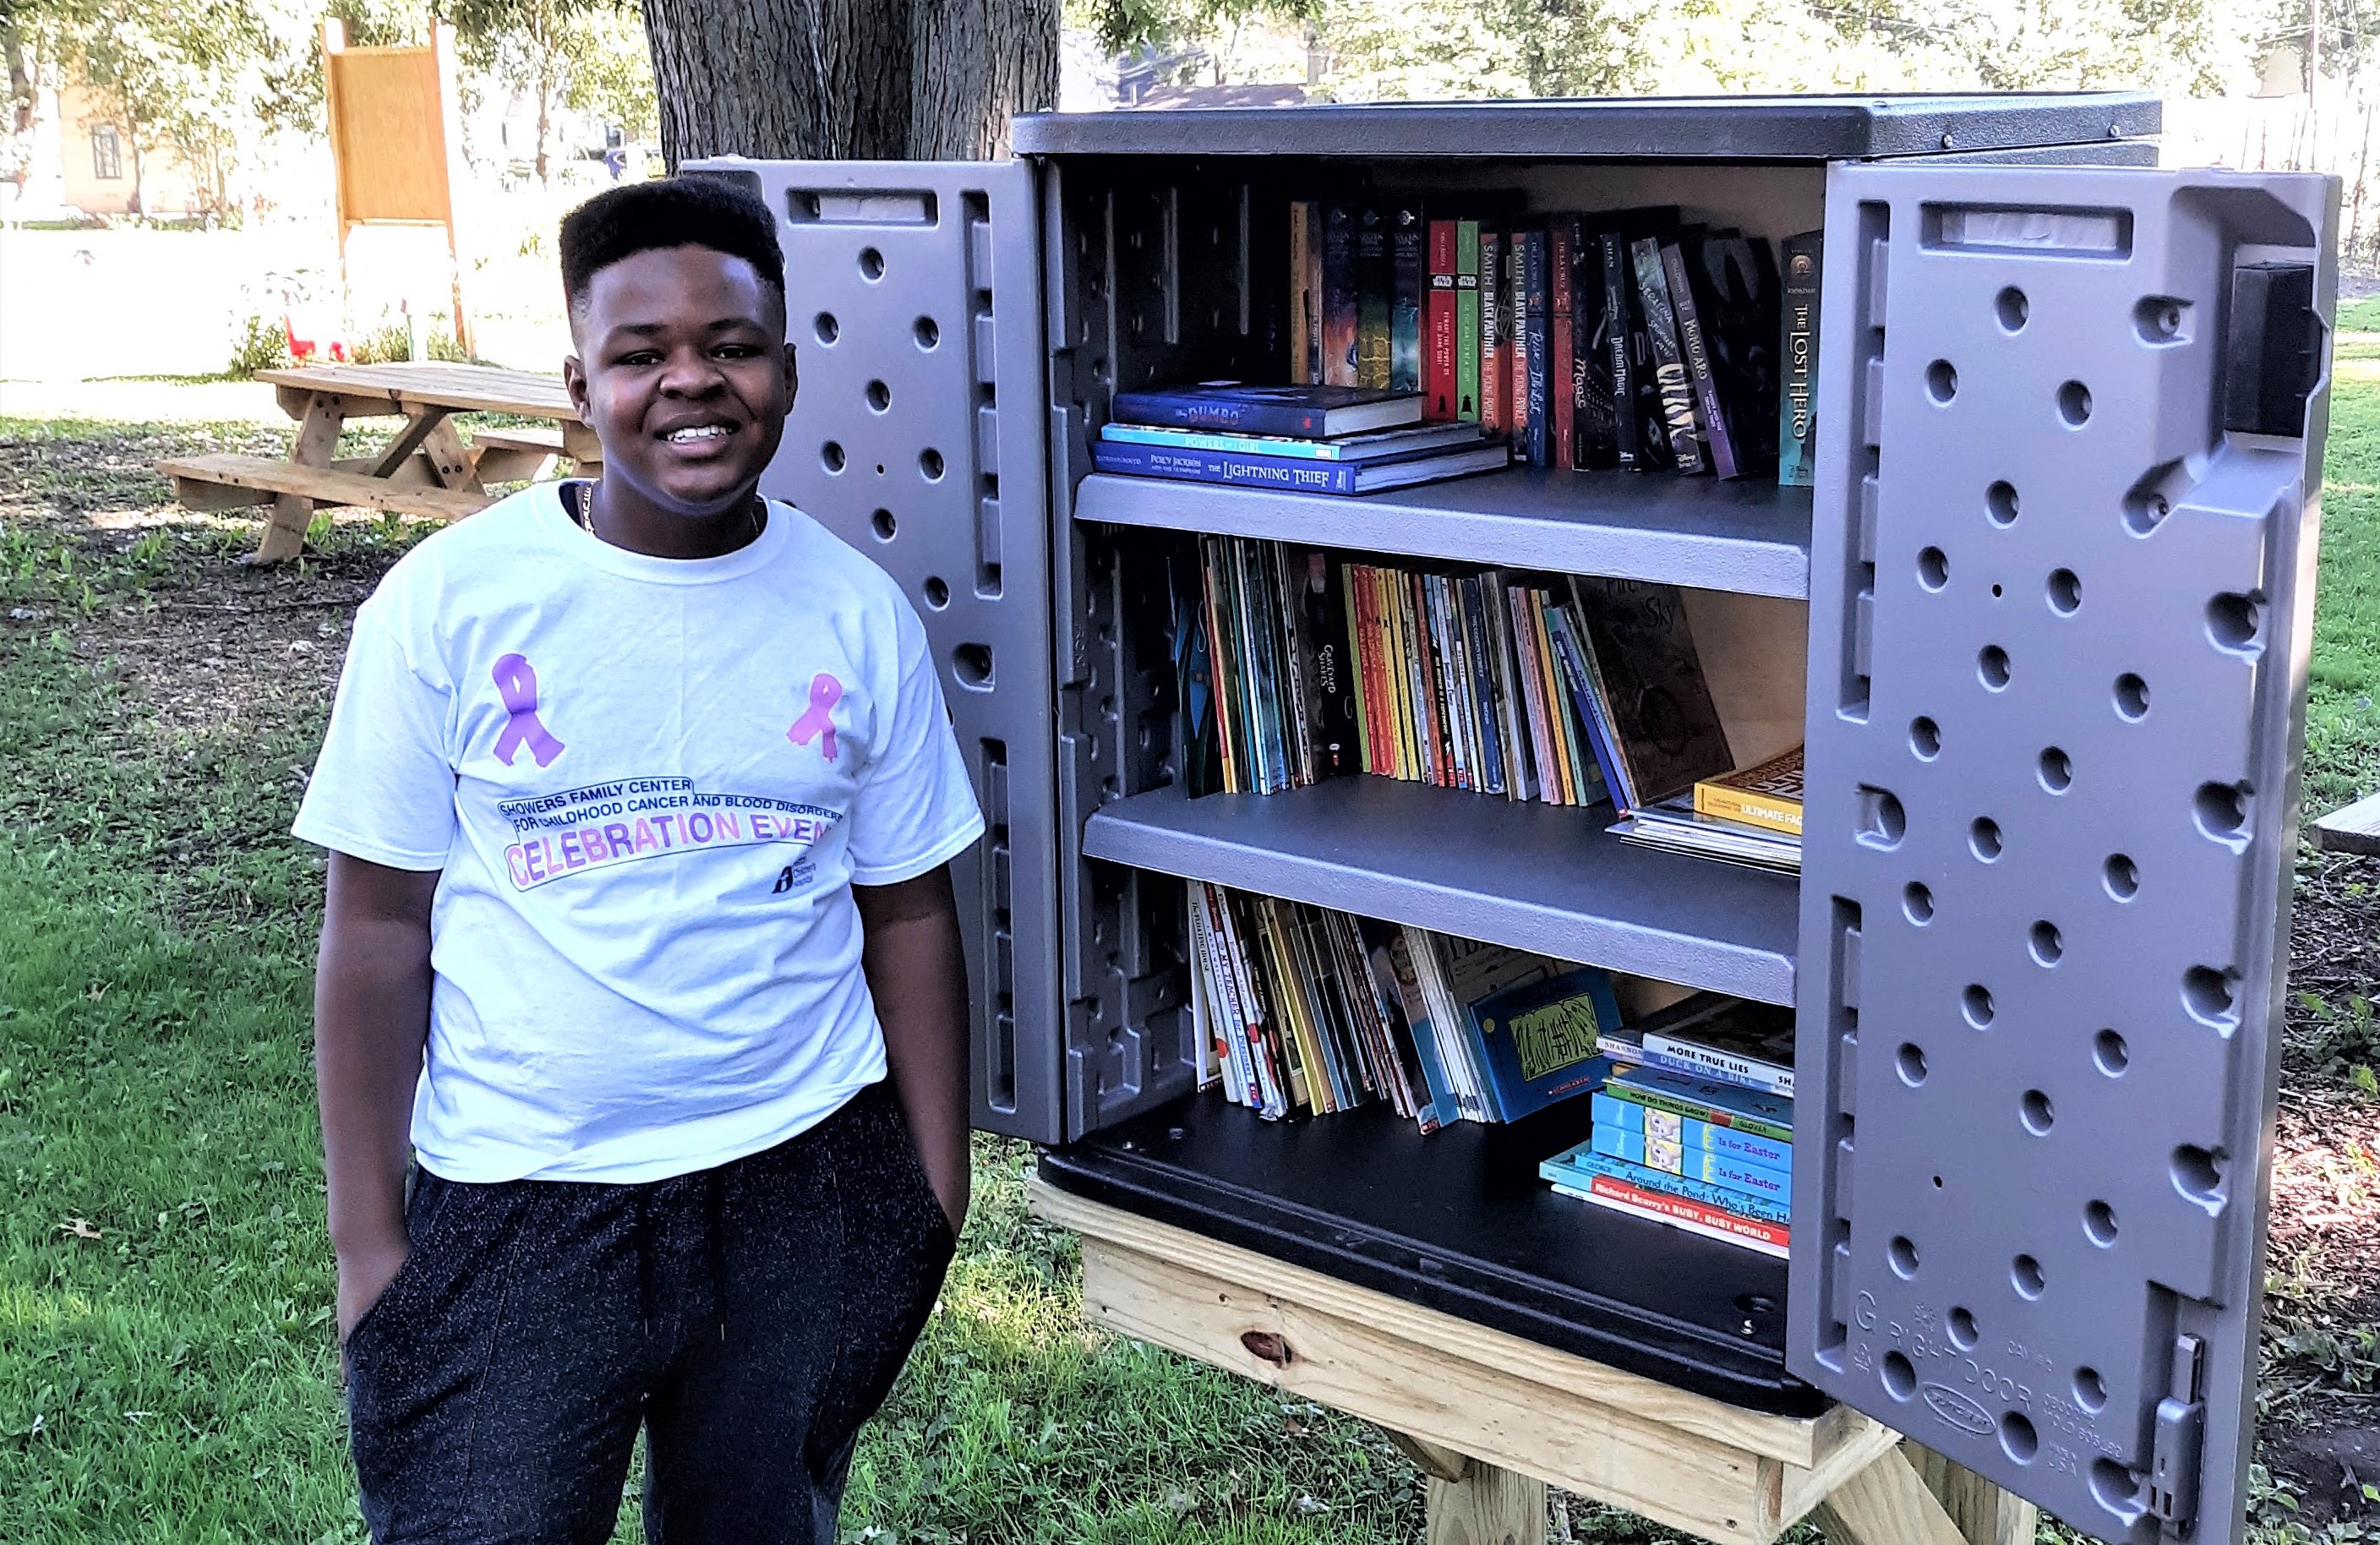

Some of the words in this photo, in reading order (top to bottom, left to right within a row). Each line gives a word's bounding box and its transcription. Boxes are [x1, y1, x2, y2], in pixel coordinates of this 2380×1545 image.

[1483, 245, 1493, 286] SMITH
[1515, 244, 1526, 286] SMITH
[1483, 292, 1493, 319] BLACK
[1515, 292, 1526, 318] BLACK
[1794, 303, 1809, 330] THE
[1483, 319, 1493, 358] PANTHER
[1515, 319, 1526, 358] PANTHER
[1789, 330, 1810, 374] LOST
[1483, 361, 1493, 372] THE
[1515, 361, 1526, 372] THE
[1483, 374, 1493, 396] YOUNG
[1515, 374, 1526, 395] YOUNG
[1571, 358, 1587, 408] Magic
[1186, 406, 1240, 425] DUMBO
[1483, 397, 1493, 420] PRINCE
[1515, 397, 1526, 420] PRINCE
[1789, 383, 1810, 439] HERO
[1185, 436, 1225, 449] POWERS
[1239, 441, 1260, 453] GIRL
[1223, 461, 1289, 481] LIGHTNING
[1293, 470, 1330, 488] THIEF
[1646, 596, 1674, 635] Sky
[1318, 652, 1328, 686] SHAKES
[1324, 644, 1336, 694] GRAVEYARD
[499, 795, 566, 816] SHOWERS
[570, 783, 624, 803] FAMILY
[629, 779, 691, 794] CENTER
[1741, 803, 1785, 823] ULTIMATE
[514, 818, 539, 833] FOR
[539, 803, 624, 827] CHILDHOOD
[628, 796, 689, 812] CANCER
[693, 796, 721, 807] AND
[725, 796, 772, 809] BLOOD
[777, 801, 843, 822] DISORDERS
[506, 811, 740, 887] CELEBRATION
[1193, 914, 1206, 949] FLOATING
[1200, 949, 1210, 973] HOUSE
[1220, 953, 1230, 969] MY
[1224, 973, 1241, 1016] TEACHER
[1605, 1042, 1642, 1056] SHANNON
[1660, 1055, 1690, 1070] DUCK
[1695, 1063, 1711, 1074] ON
[1717, 1070, 1723, 1078] A
[1728, 1072, 1754, 1085] BIKE
[1667, 1045, 1696, 1060] MORE
[1700, 1054, 1725, 1067] TRUE
[1729, 1062, 1749, 1074] LIES
[1778, 1076, 1793, 1087] SH
[1718, 1138, 1727, 1146] Is
[1728, 1140, 1742, 1150] for
[1744, 1142, 1780, 1160] Easter
[1718, 1167, 1727, 1176] Is
[1728, 1171, 1742, 1181] for
[1744, 1172, 1781, 1191] Easter
[1595, 1182, 1629, 1201] Richard
[1631, 1193, 1672, 1212] Scarry's
[1673, 1204, 1703, 1222] BUSY,
[1705, 1215, 1732, 1230] BUSY
[1733, 1222, 1771, 1240] WORLD
[1625, 1171, 1661, 1188] Around
[1663, 1182, 1679, 1193] the
[1712, 1192, 1744, 1213] Who's
[1748, 1204, 1773, 1220] Been
[1777, 1211, 1790, 1223] H
